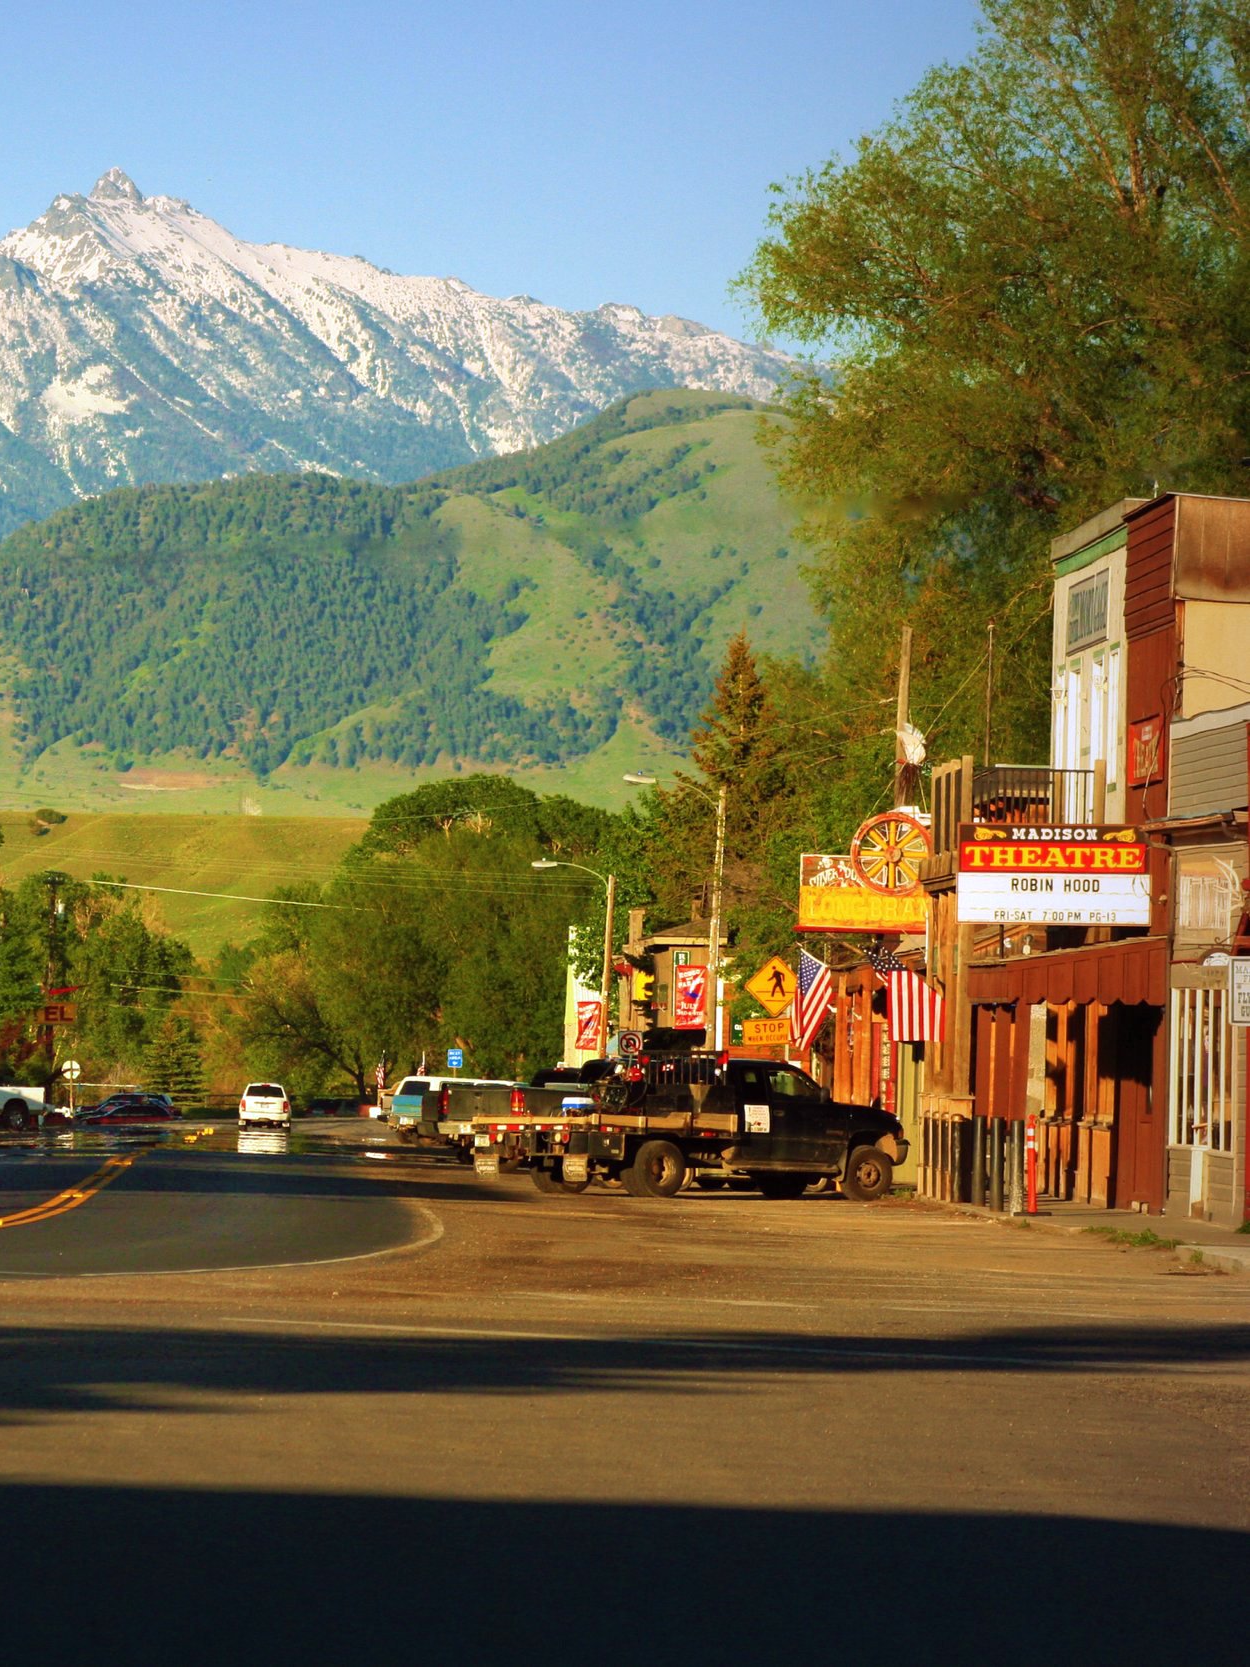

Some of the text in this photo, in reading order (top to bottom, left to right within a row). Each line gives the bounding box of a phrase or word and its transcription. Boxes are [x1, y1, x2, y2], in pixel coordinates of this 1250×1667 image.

[1011, 827, 1098, 841] MADISON
[965, 846, 1142, 869] THEATRE
[1011, 878, 1100, 893] ROBIN HOOD
[994, 910, 1033, 921] FRI-SAT
[1067, 912, 1082, 921] PM
[1089, 912, 1117, 922] PG-13
[45, 1005, 74, 1022] EL
[754, 1022, 785, 1034] STOP
